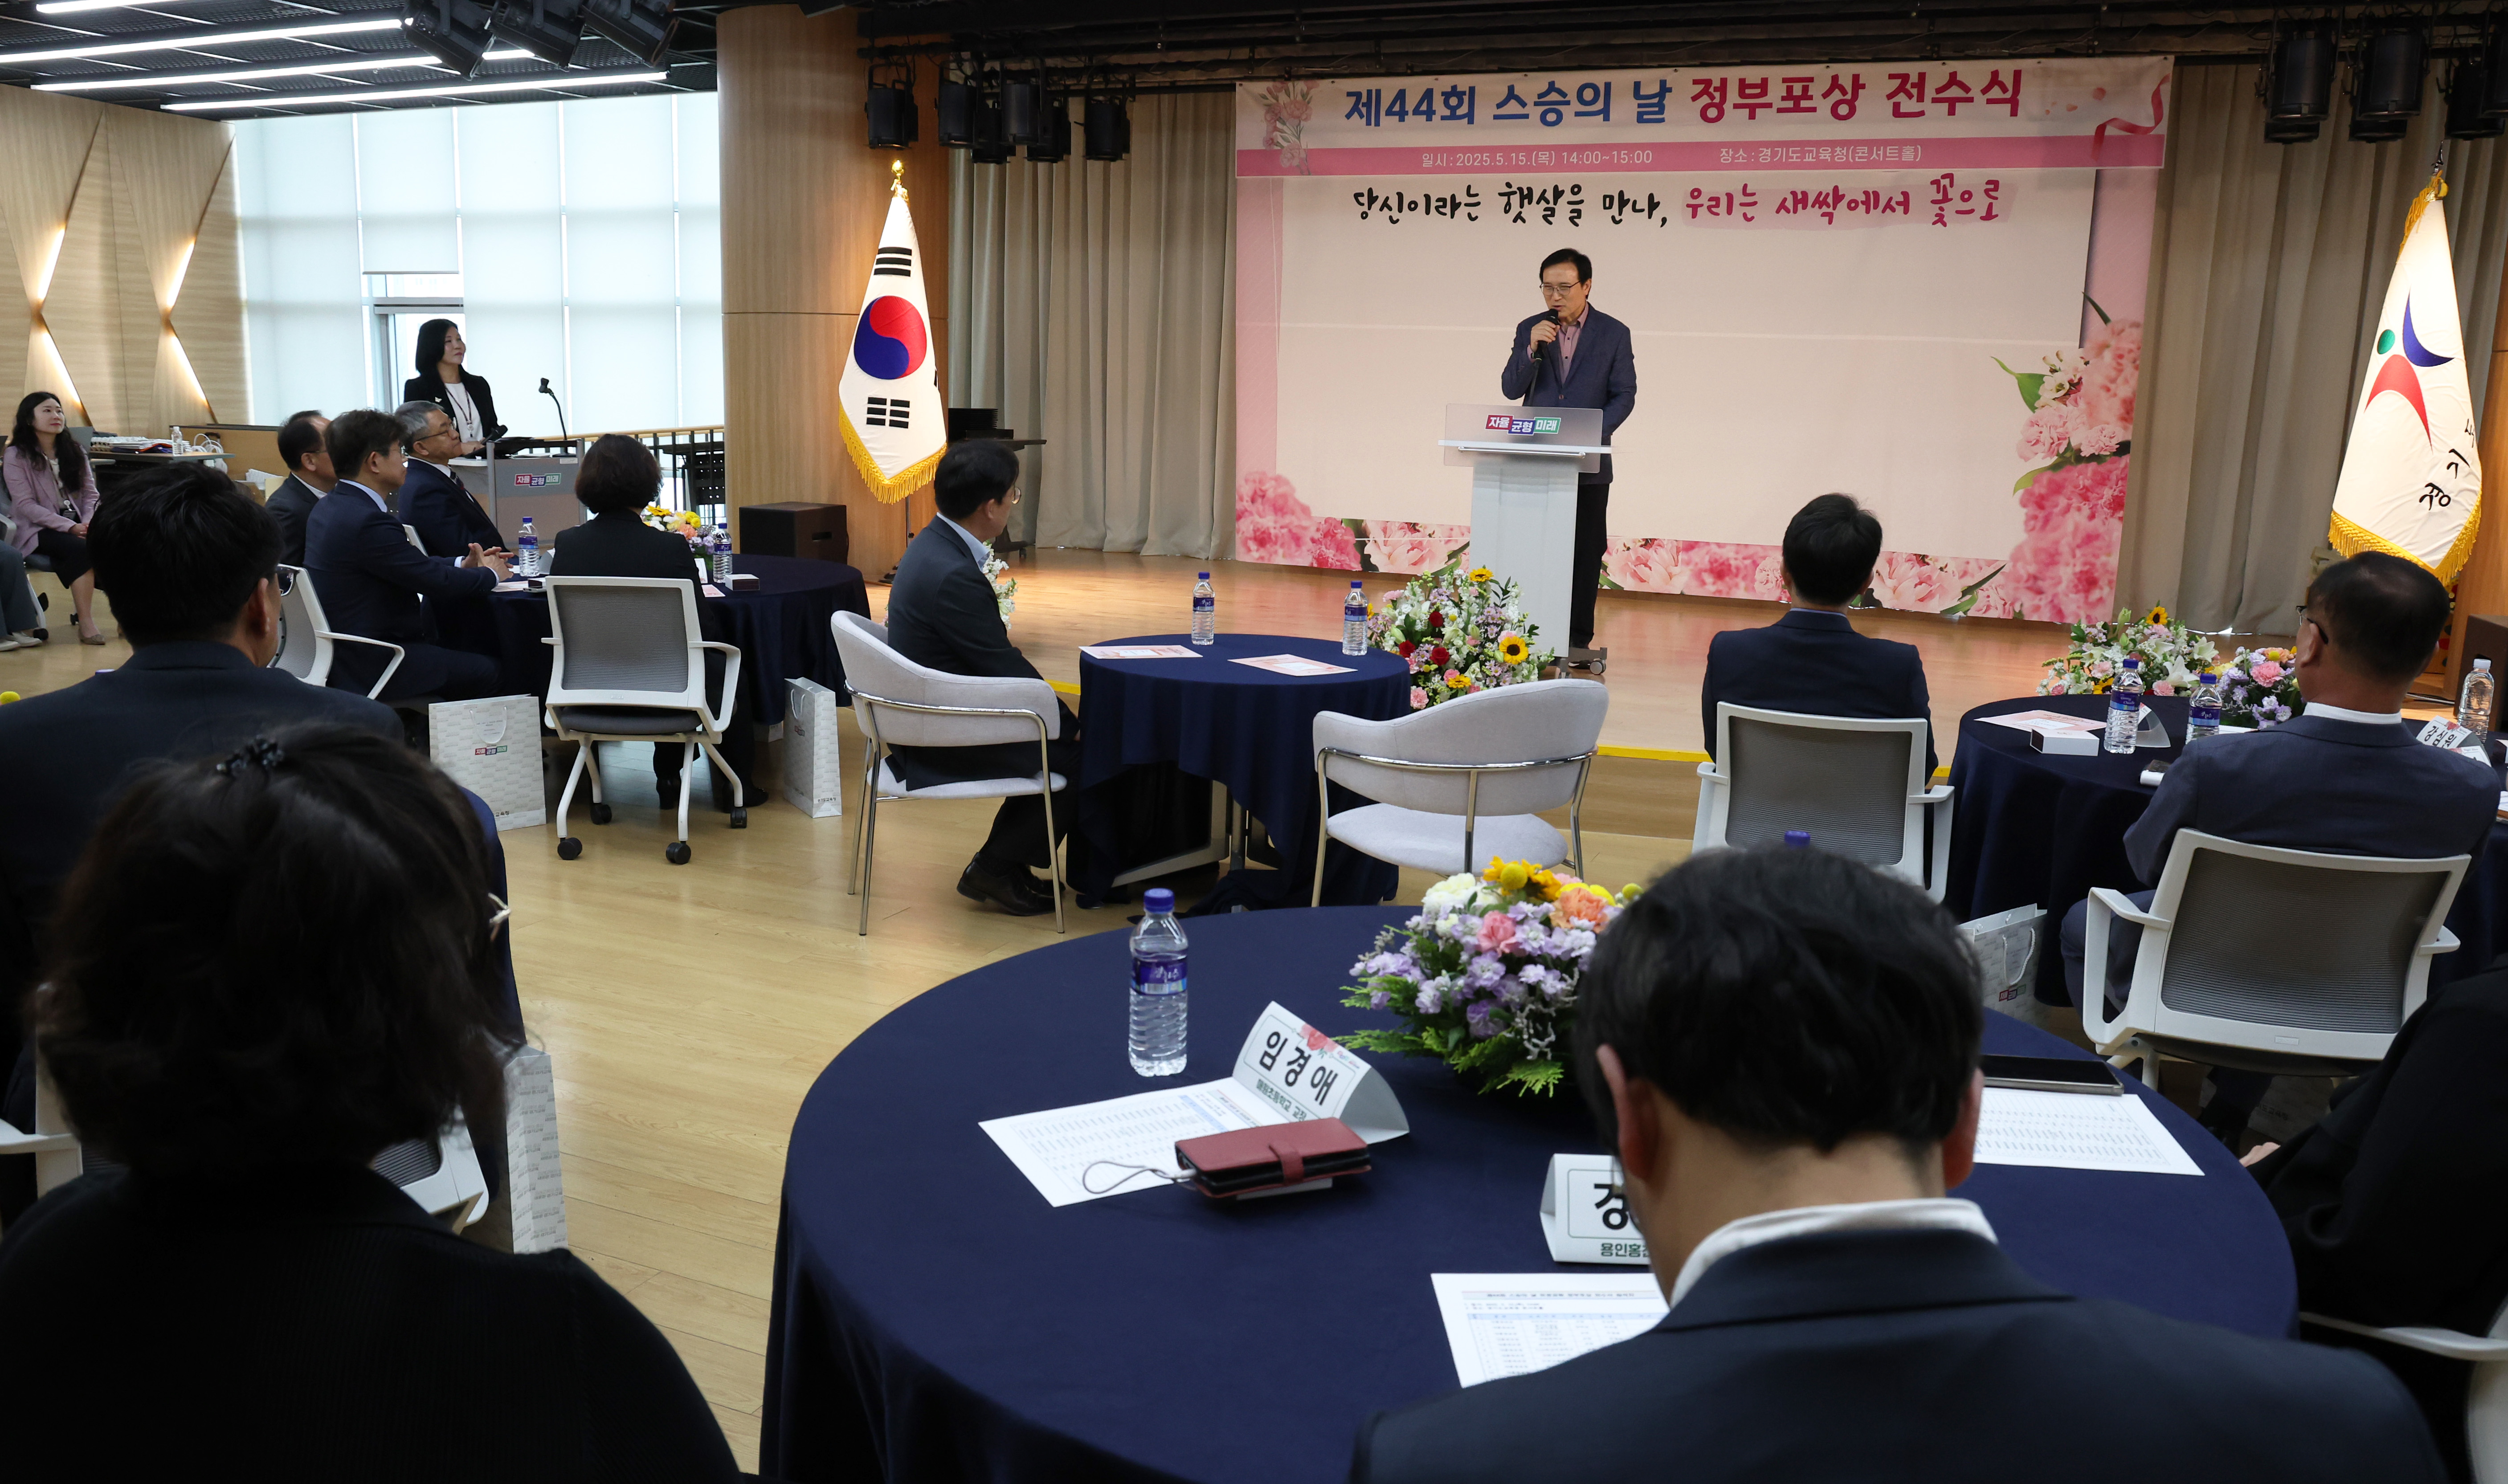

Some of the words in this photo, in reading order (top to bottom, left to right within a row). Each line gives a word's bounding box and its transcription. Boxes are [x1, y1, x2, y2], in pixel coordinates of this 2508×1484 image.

[1344, 84, 1477, 127] 제44회
[1493, 80, 1611, 126] 스승의
[1632, 79, 1672, 123] 날
[1691, 73, 1866, 123] 정부포상
[1885, 69, 2022, 119] 전수식
[1562, 150, 1652, 164] 14:00~15:00
[1353, 183, 1482, 224] 당신이라는
[1498, 181, 1585, 227] 햇살을
[1602, 187, 1668, 228] 만나,
[1685, 183, 1759, 222] 우리는
[1775, 185, 1911, 226] 새싹에서
[1929, 173, 2001, 228] 꽃으로
[1488, 416, 1510, 428] 자율
[1511, 421, 1533, 433] 균형
[1535, 420, 1557, 431] 미래
[517, 475, 530, 483] 자율
[531, 477, 545, 485] 균형
